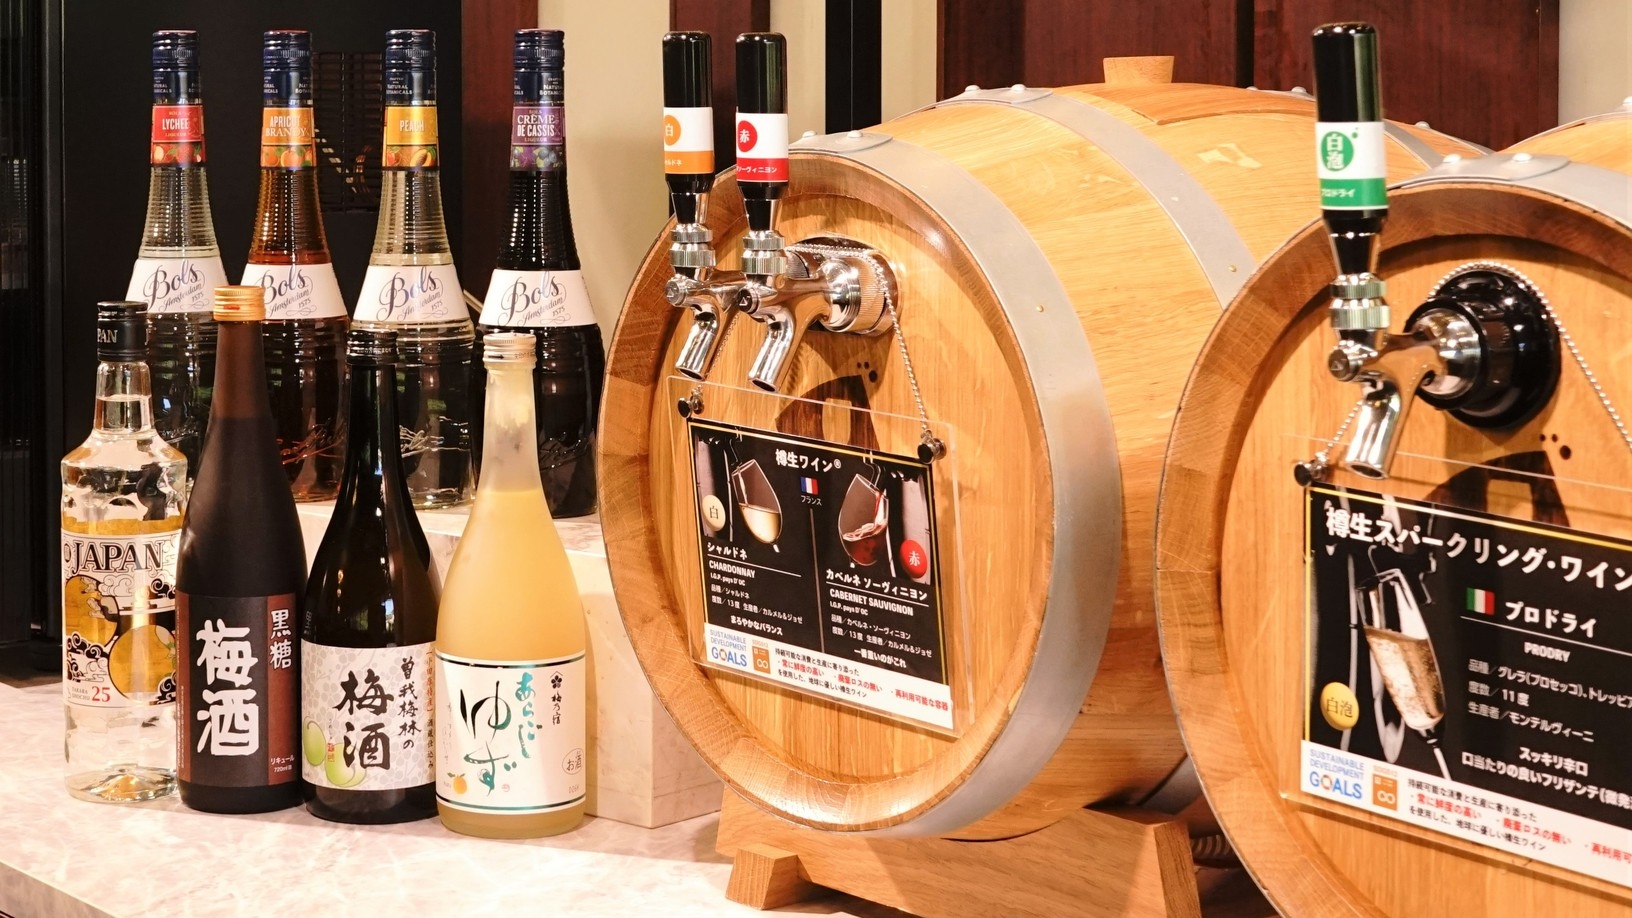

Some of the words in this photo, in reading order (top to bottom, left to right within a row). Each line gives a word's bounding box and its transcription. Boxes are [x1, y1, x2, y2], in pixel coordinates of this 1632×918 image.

[162, 118, 189, 131] LYCHEE
[270, 116, 301, 127] APRICOT
[399, 119, 425, 132] PEACH
[517, 113, 556, 124] CRÈME
[265, 127, 307, 137] BRANDY
[517, 125, 526, 136] DE
[527, 125, 555, 136] CASSIS
[665, 123, 674, 136] 白
[739, 129, 750, 143] 赤
[143, 259, 200, 312] Bols
[259, 263, 307, 305] Bols
[377, 266, 436, 321] Bols
[160, 282, 203, 313] Amsterdam
[192, 291, 205, 302] 1575
[269, 286, 312, 316] Amsterdam
[298, 297, 312, 308] 1575
[431, 301, 443, 311] 1575
[498, 270, 560, 326] Bols
[517, 296, 564, 326] Amsterdam
[552, 306, 566, 317] 1575
[800, 495, 823, 506] フランス
[709, 504, 719, 520] 白
[72, 540, 164, 574] JAPAN
[707, 542, 748, 560] シャルドネ
[908, 551, 921, 567] 赤
[1326, 506, 1632, 592] 樽生スパークリング・ワイン
[709, 560, 756, 578] CHARDONNAY
[826, 568, 861, 587] カベルネ
[864, 578, 928, 600] ソーヴィニヨン
[829, 588, 867, 605] CABERNET
[868, 598, 914, 616] SAUVIGNON
[1505, 600, 1597, 638] プロドライ
[270, 609, 292, 669] 黒糖
[710, 629, 747, 644] SUSTAINABLE
[710, 637, 747, 651] DEVELOPMENT
[711, 646, 747, 667] GOALS
[1524, 642, 1571, 663] PRODRY
[91, 685, 110, 702] 25
[196, 618, 260, 756] 梅酒
[515, 671, 543, 759] あらごし
[551, 692, 562, 726] 梅乃宿
[1326, 697, 1354, 719] 白泡
[333, 668, 394, 770] 梅酒
[459, 680, 517, 797] ゆず
[270, 755, 295, 765] リキュール
[566, 751, 582, 771] お酒
[1310, 748, 1365, 771] SUSTAINABLE
[1310, 758, 1364, 780] DEVELOPMENT
[1519, 746, 1589, 777] スッキリ辛口
[1309, 770, 1362, 800] GOALS
